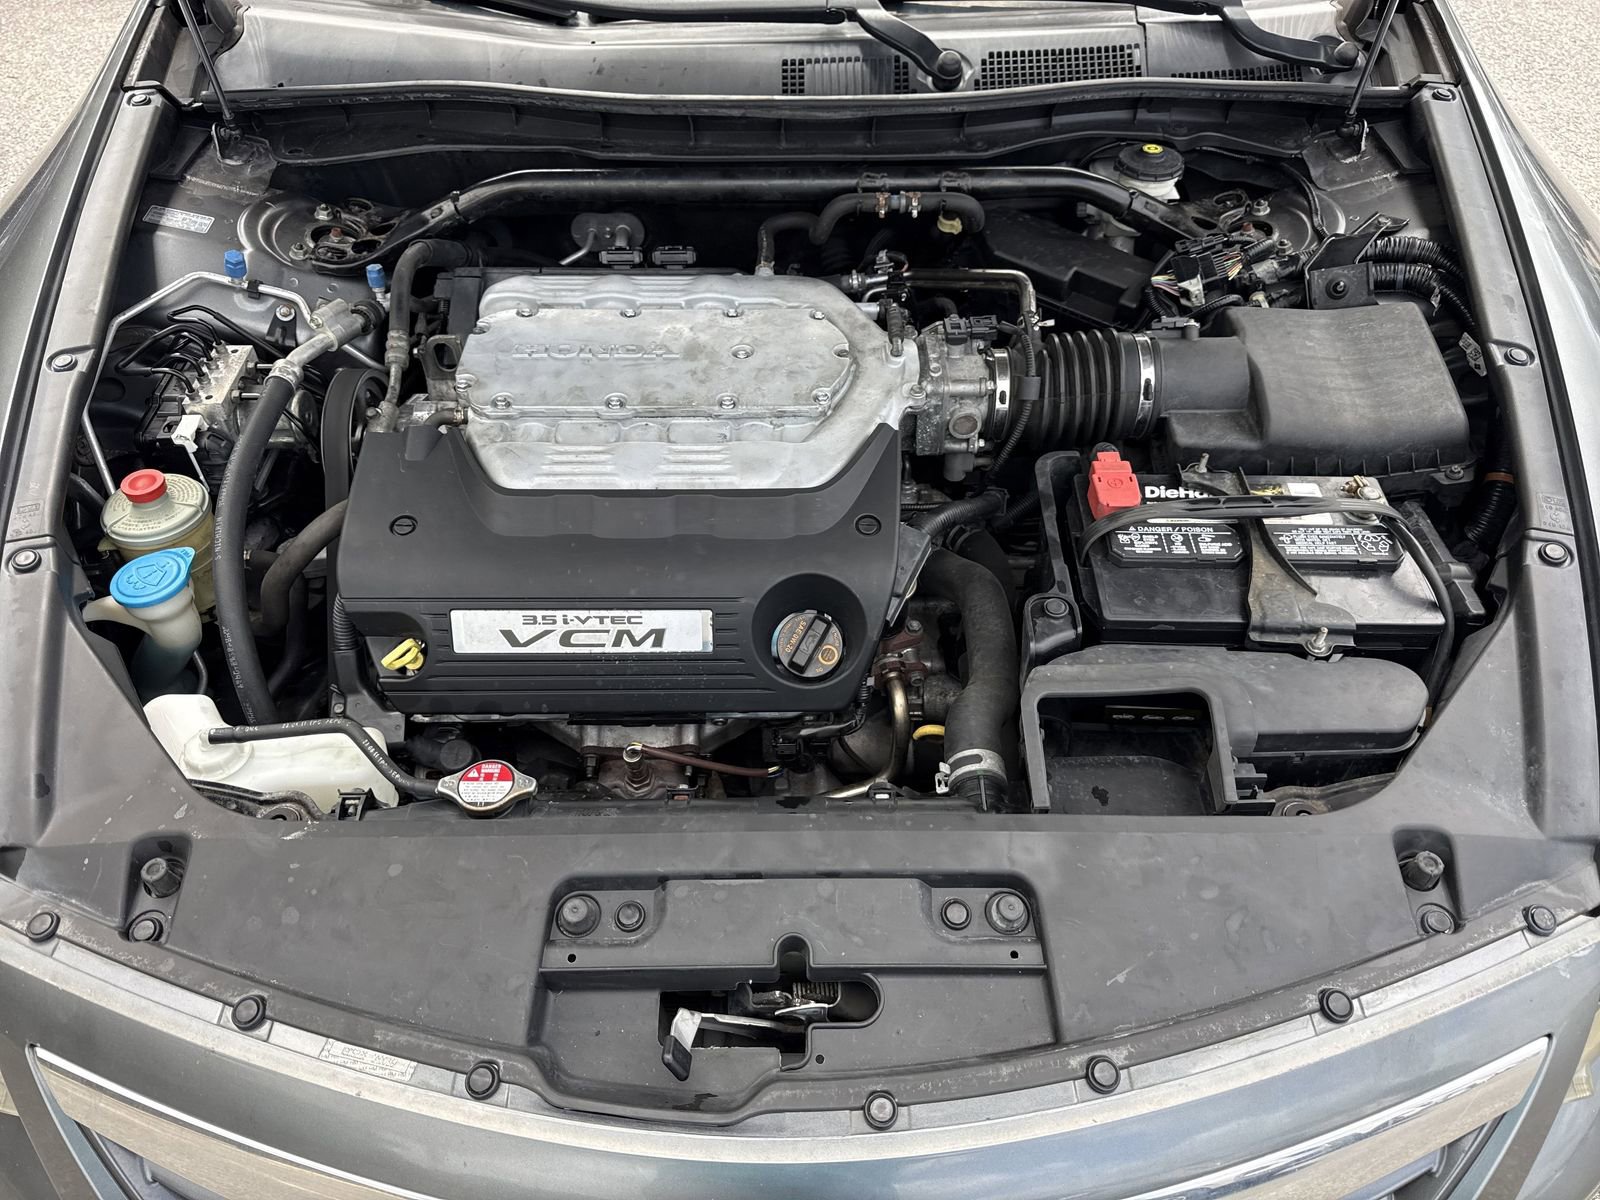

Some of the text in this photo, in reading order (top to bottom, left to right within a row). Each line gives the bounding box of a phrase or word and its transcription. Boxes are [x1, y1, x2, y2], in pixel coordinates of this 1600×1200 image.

[512, 344, 679, 359] HONDA
[1144, 485, 1214, 499] DieHa
[522, 614, 644, 625] 3.5 i-VTEC
[795, 620, 807, 634] SAE
[499, 628, 667, 648] VCM
[784, 633, 799, 653] 0W-20
